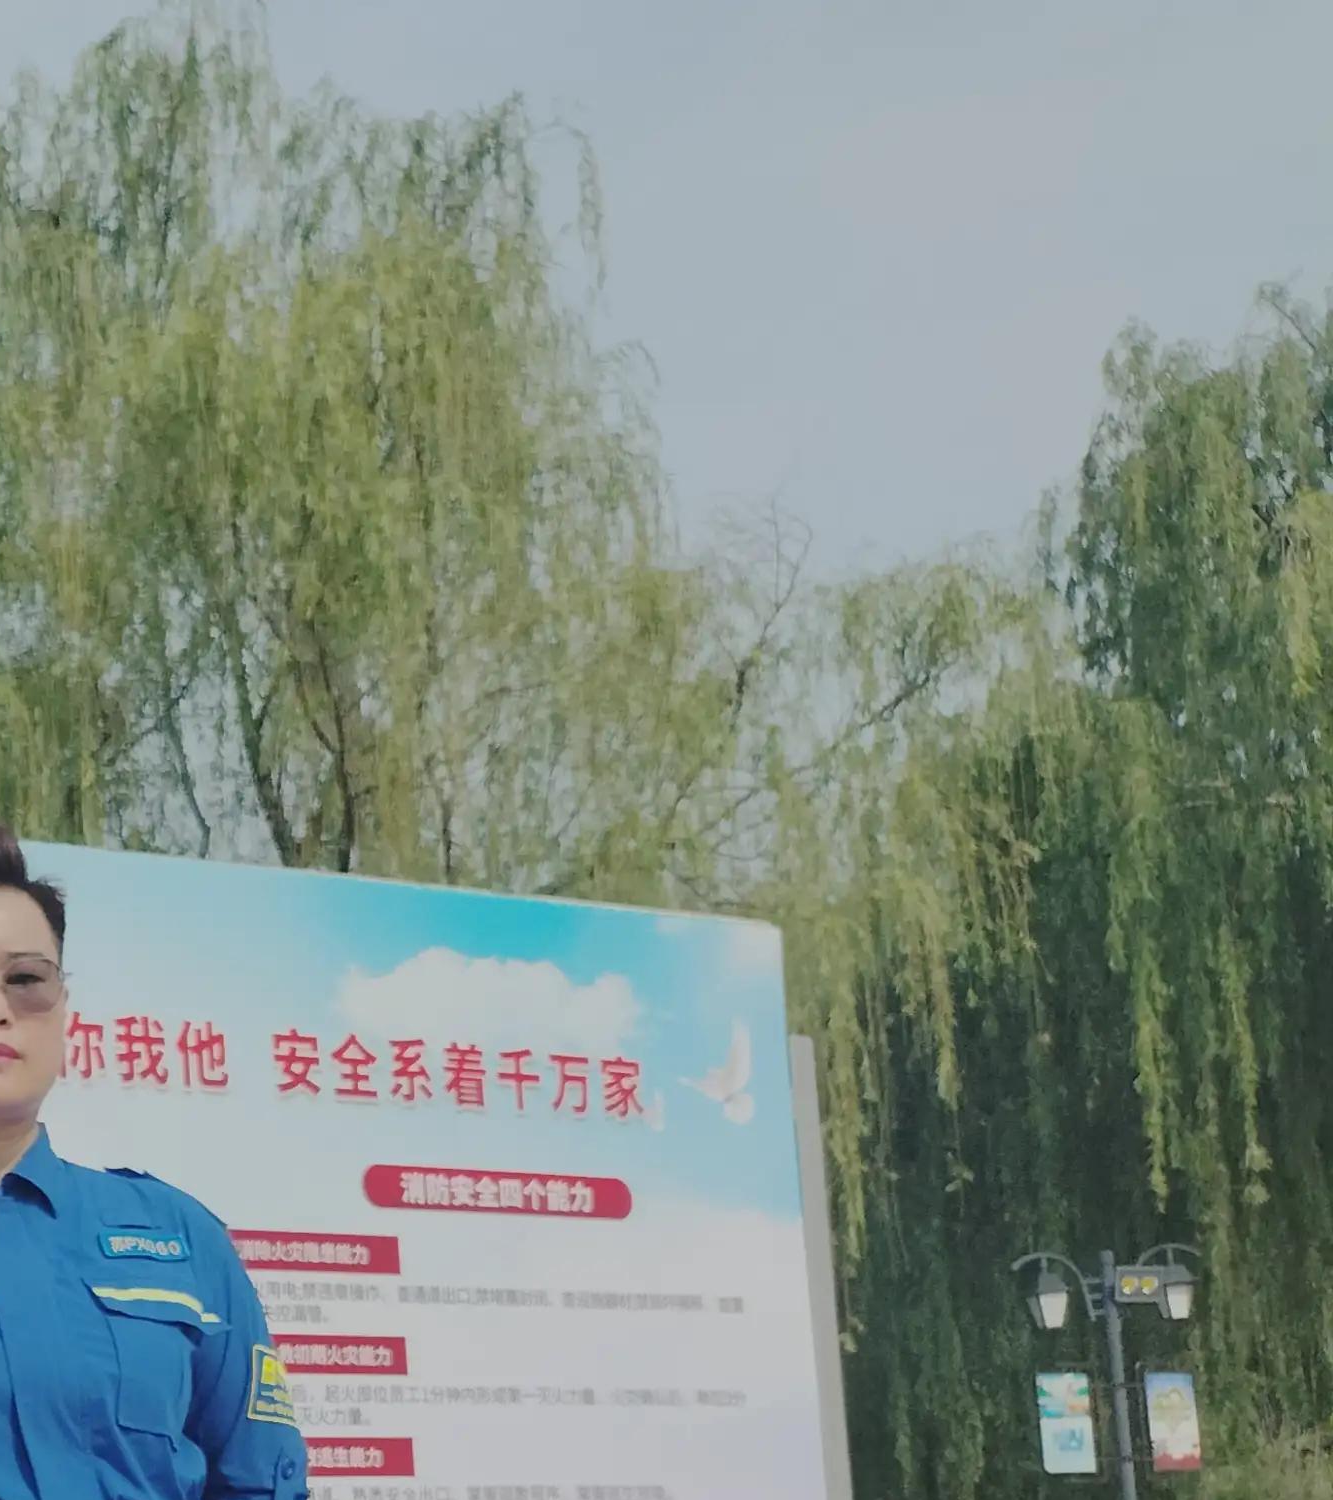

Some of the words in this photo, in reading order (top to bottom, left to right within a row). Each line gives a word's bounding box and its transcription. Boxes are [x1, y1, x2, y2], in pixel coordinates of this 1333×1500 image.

[272, 1029, 644, 1118] 安全系着千万家
[400, 1171, 594, 1214] 消防安全四个能力
